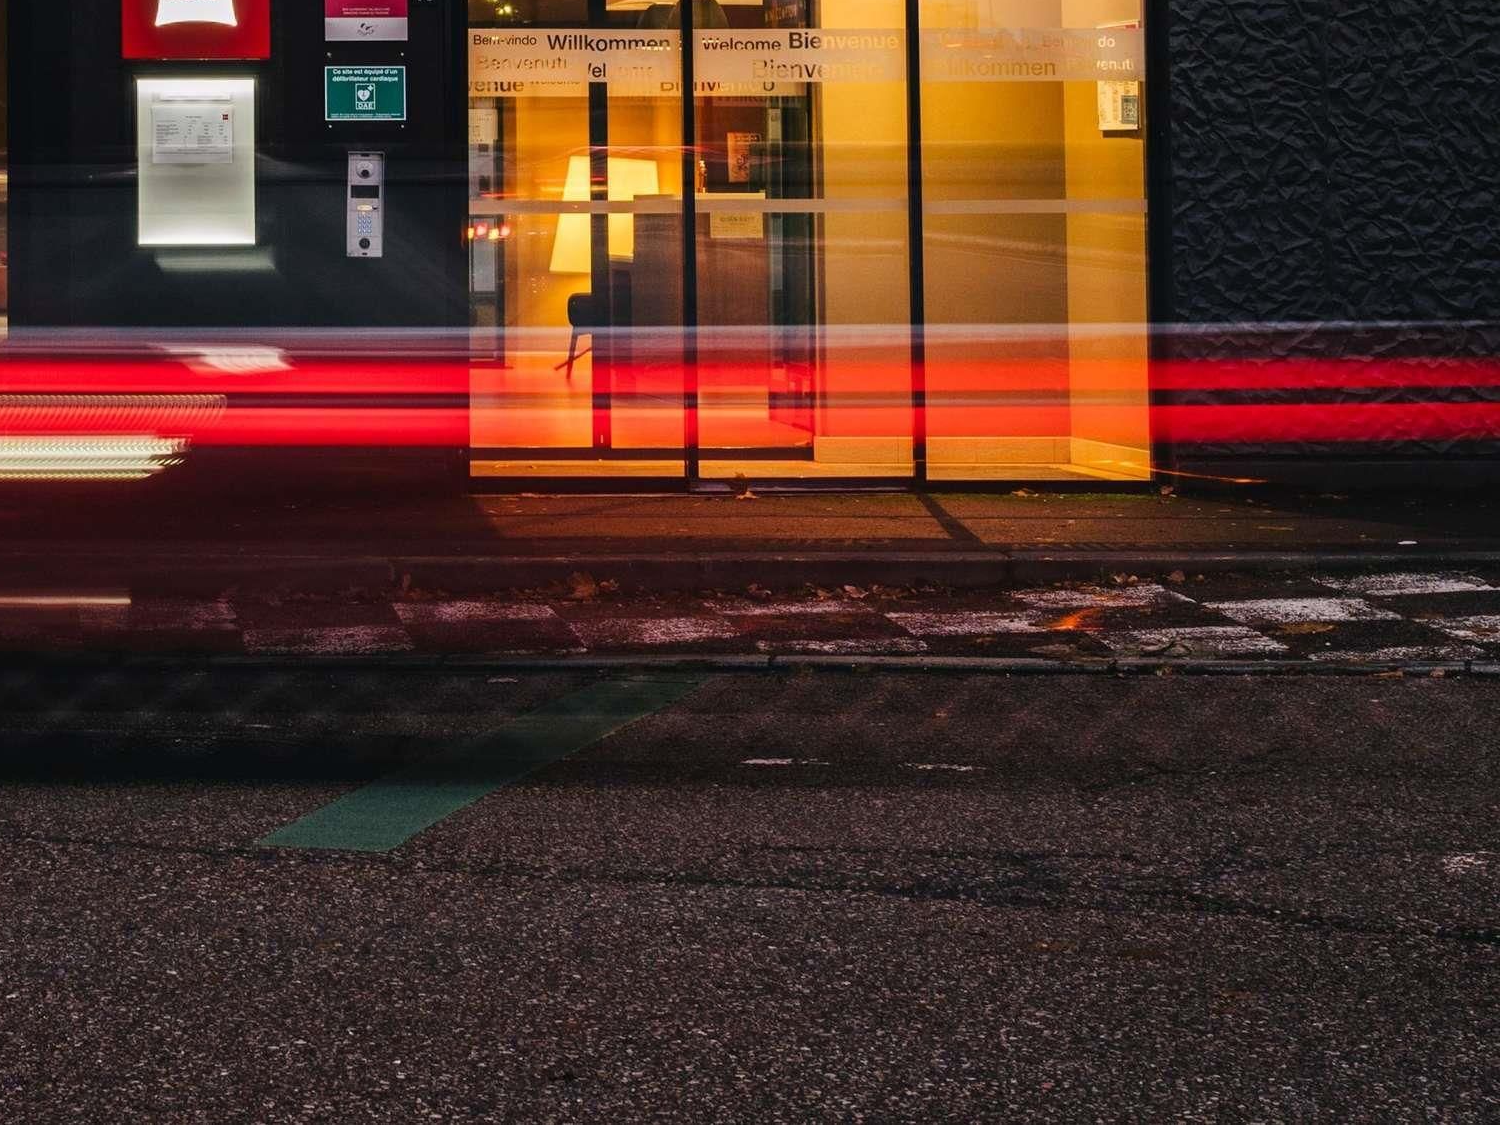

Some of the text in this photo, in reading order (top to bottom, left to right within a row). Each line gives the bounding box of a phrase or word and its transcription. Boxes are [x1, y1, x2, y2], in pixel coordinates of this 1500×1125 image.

[473, 34, 670, 51] Bem-vindo Willkommen
[789, 32, 899, 49] Bienvenue
